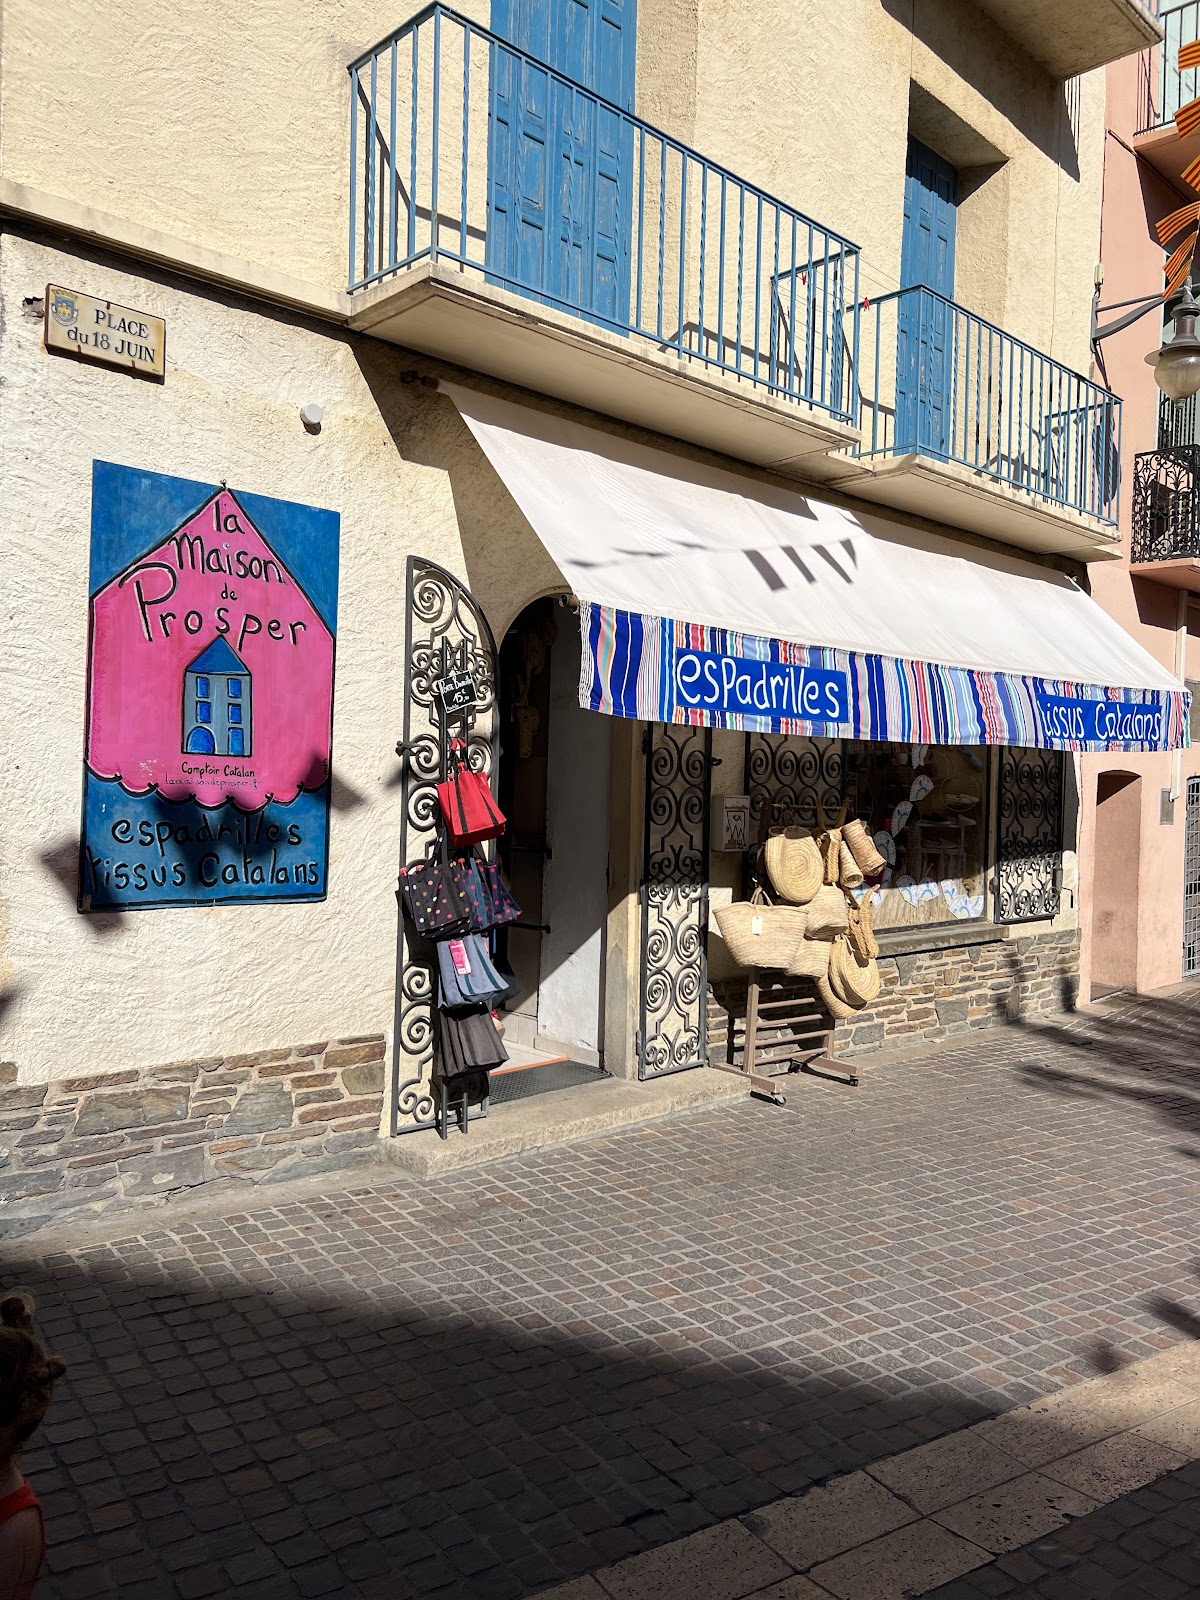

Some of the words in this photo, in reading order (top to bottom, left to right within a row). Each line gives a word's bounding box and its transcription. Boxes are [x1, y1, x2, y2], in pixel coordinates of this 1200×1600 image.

[95, 308, 149, 340] PLACE
[67, 326, 89, 345] du
[92, 331, 111, 350] 18
[115, 338, 156, 363] JUIN
[213, 499, 245, 534] la
[118, 561, 307, 652] Prosper
[221, 583, 238, 601] de
[1095, 702, 1161, 741] Catalans
[181, 761, 220, 779] Comptoir
[224, 764, 255, 778] Catalan
[111, 811, 303, 858] espadrilles
[85, 845, 187, 892] tissus
[198, 848, 320, 888] Catalans
